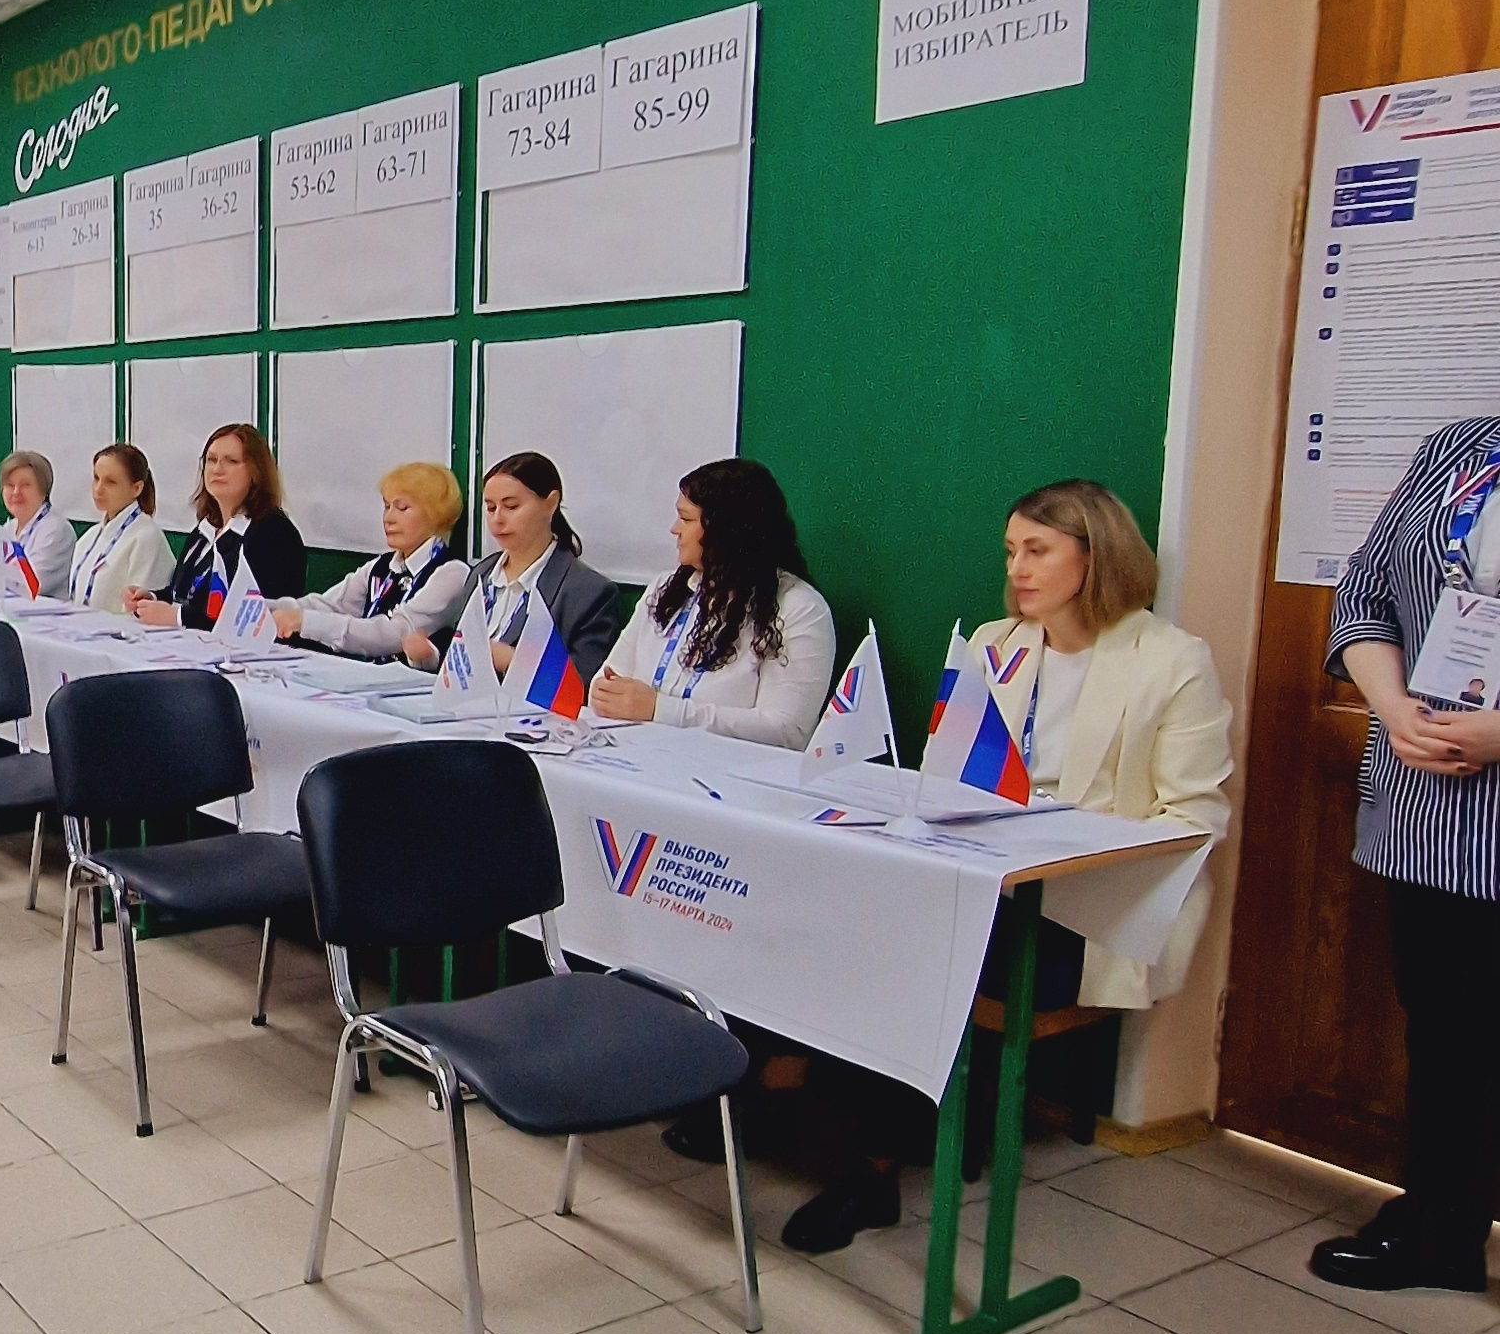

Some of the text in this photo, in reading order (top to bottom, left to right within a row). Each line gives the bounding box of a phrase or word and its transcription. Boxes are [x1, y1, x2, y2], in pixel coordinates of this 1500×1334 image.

[894, 10, 1069, 69] ИЗБИРАТЕЛЬ
[610, 37, 739, 88] Гагарина
[486, 71, 598, 118] Гагарина
[632, 87, 711, 132] 85-99
[13, 84, 120, 194] Сегодня
[362, 110, 448, 147] Гагарина
[508, 118, 572, 159] 73-84
[276, 132, 353, 166] Гагарина
[189, 157, 252, 188] Гагарина
[376, 150, 427, 184] 63-71
[128, 175, 184, 203] Гагарина
[290, 169, 336, 201] 53-62
[60, 195, 109, 219] Гагарина
[148, 210, 163, 231] 35
[201, 191, 238, 219] 36-52
[71, 222, 100, 246] 26-34
[663, 839, 730, 870] ВЫБОРЫ
[647, 874, 707, 905] РОССИИ
[655, 857, 749, 898] ПРЕЗИДЕНТА
[670, 901, 704, 922] МАРТА
[706, 913, 734, 932] 2024
